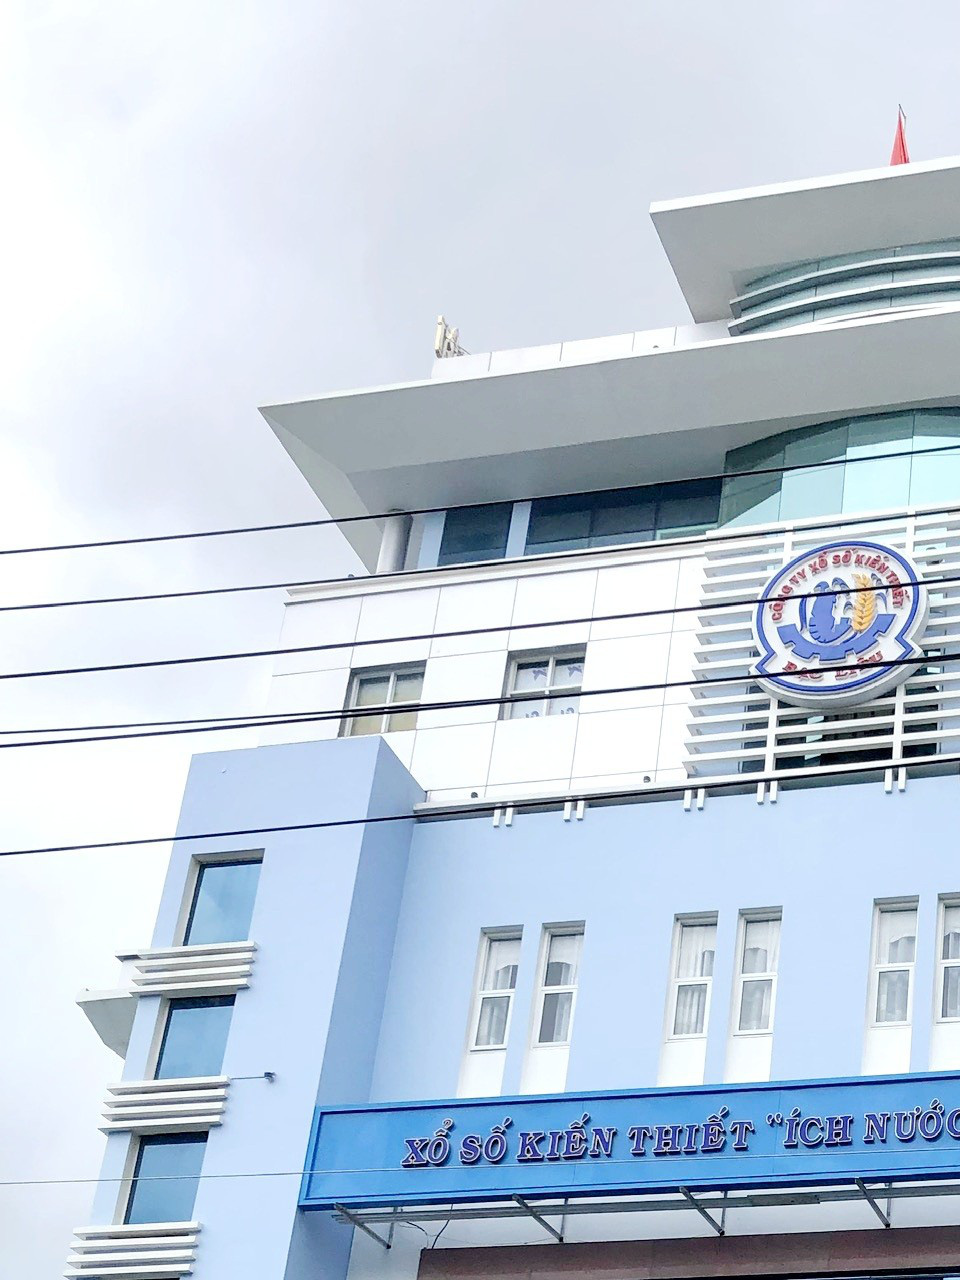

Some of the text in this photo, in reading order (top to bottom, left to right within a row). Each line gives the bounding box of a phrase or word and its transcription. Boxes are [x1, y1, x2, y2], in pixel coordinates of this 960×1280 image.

[789, 568, 807, 585] TY
[401, 1119, 454, 1168] XỔ
[460, 1116, 514, 1164] SỐ
[516, 1112, 617, 1161] KIẾN
[629, 1105, 754, 1156] THIẾT
